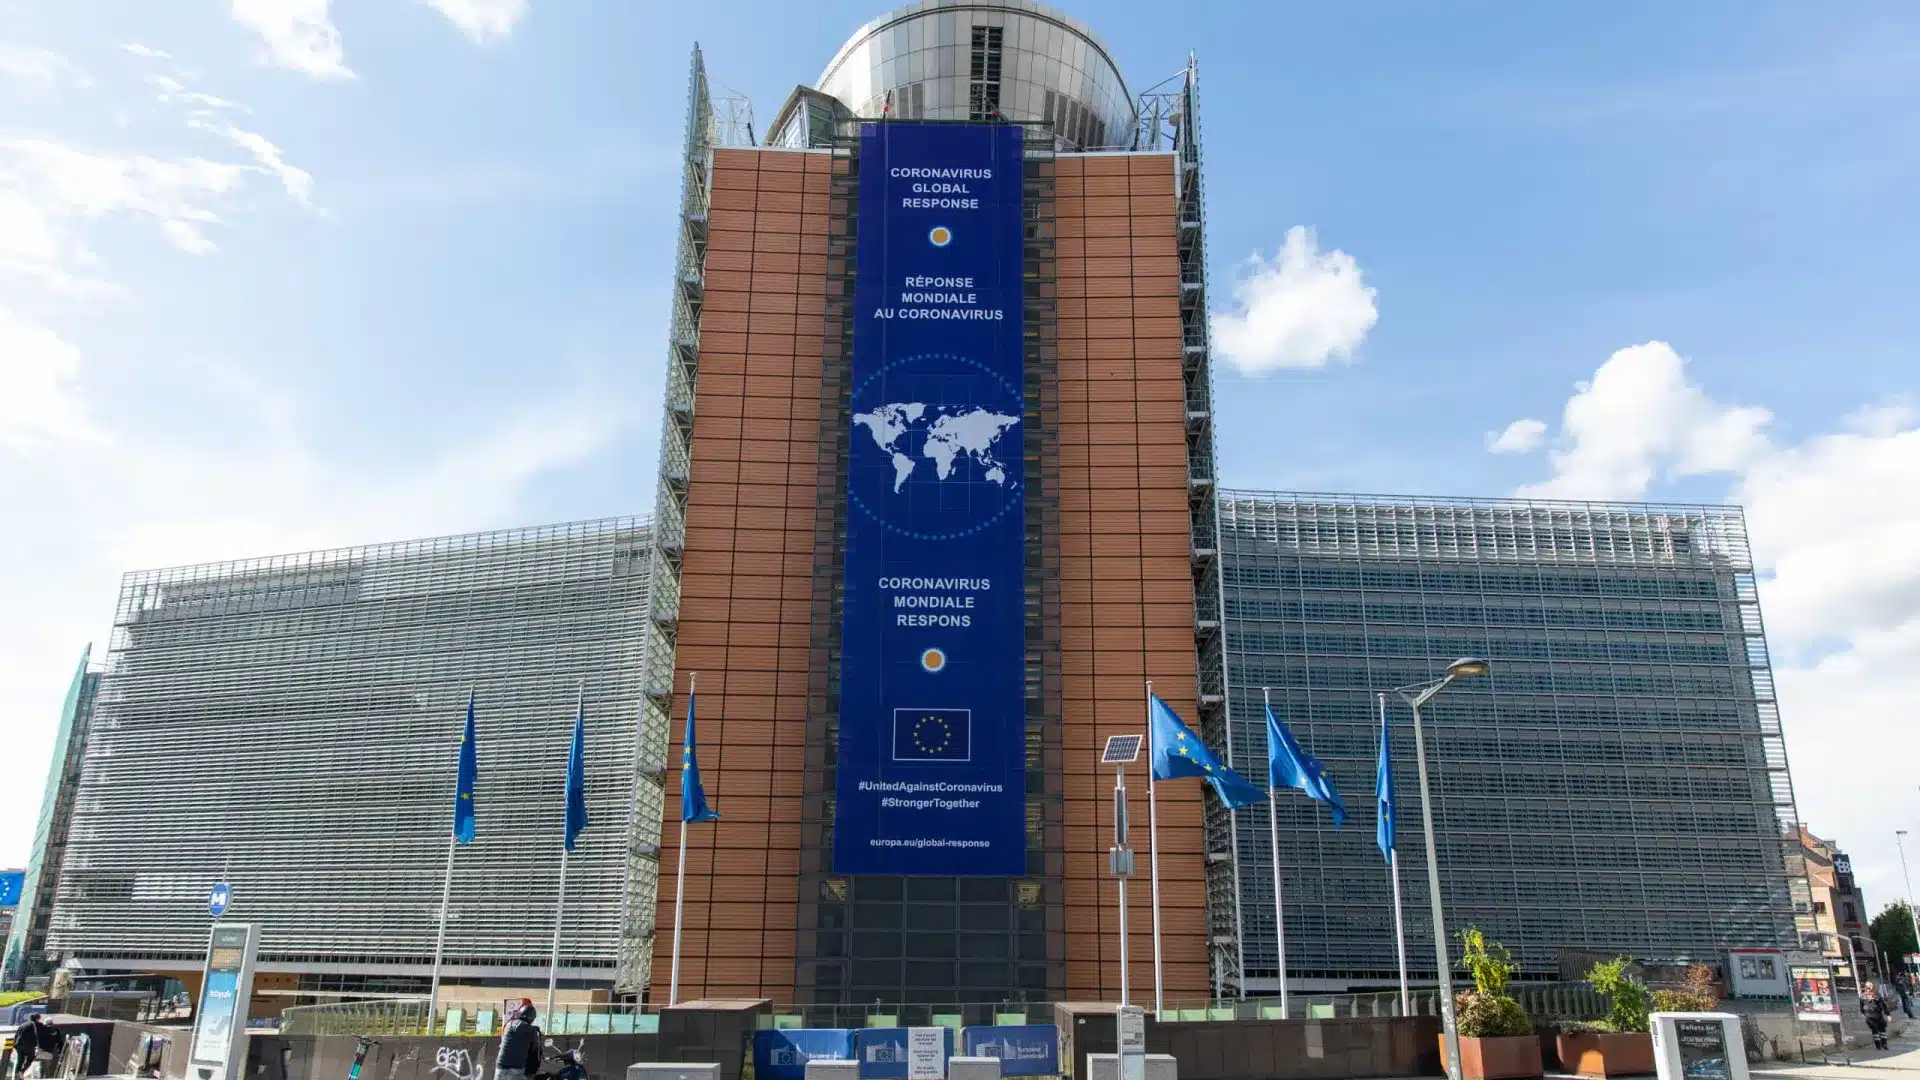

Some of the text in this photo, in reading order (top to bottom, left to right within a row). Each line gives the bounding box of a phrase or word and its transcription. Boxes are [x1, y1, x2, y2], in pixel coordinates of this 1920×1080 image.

[890, 167, 992, 179] CORONAVIRUS
[911, 182, 970, 194] GLOBAL
[902, 197, 979, 209] RESPONSE
[905, 274, 974, 288] RÉPONSE
[901, 292, 977, 304] MONDIALE
[874, 308, 1004, 321] AU CORONAVIRUS
[878, 577, 991, 591] CORONAVIRUS
[894, 595, 975, 609] MONDIALE
[896, 614, 972, 627] RESPONS
[858, 781, 1003, 794] #UnitedAgainstCoronavirus
[881, 797, 980, 810] #StrongerTogether
[869, 838, 990, 849] europa.eu/global-response
